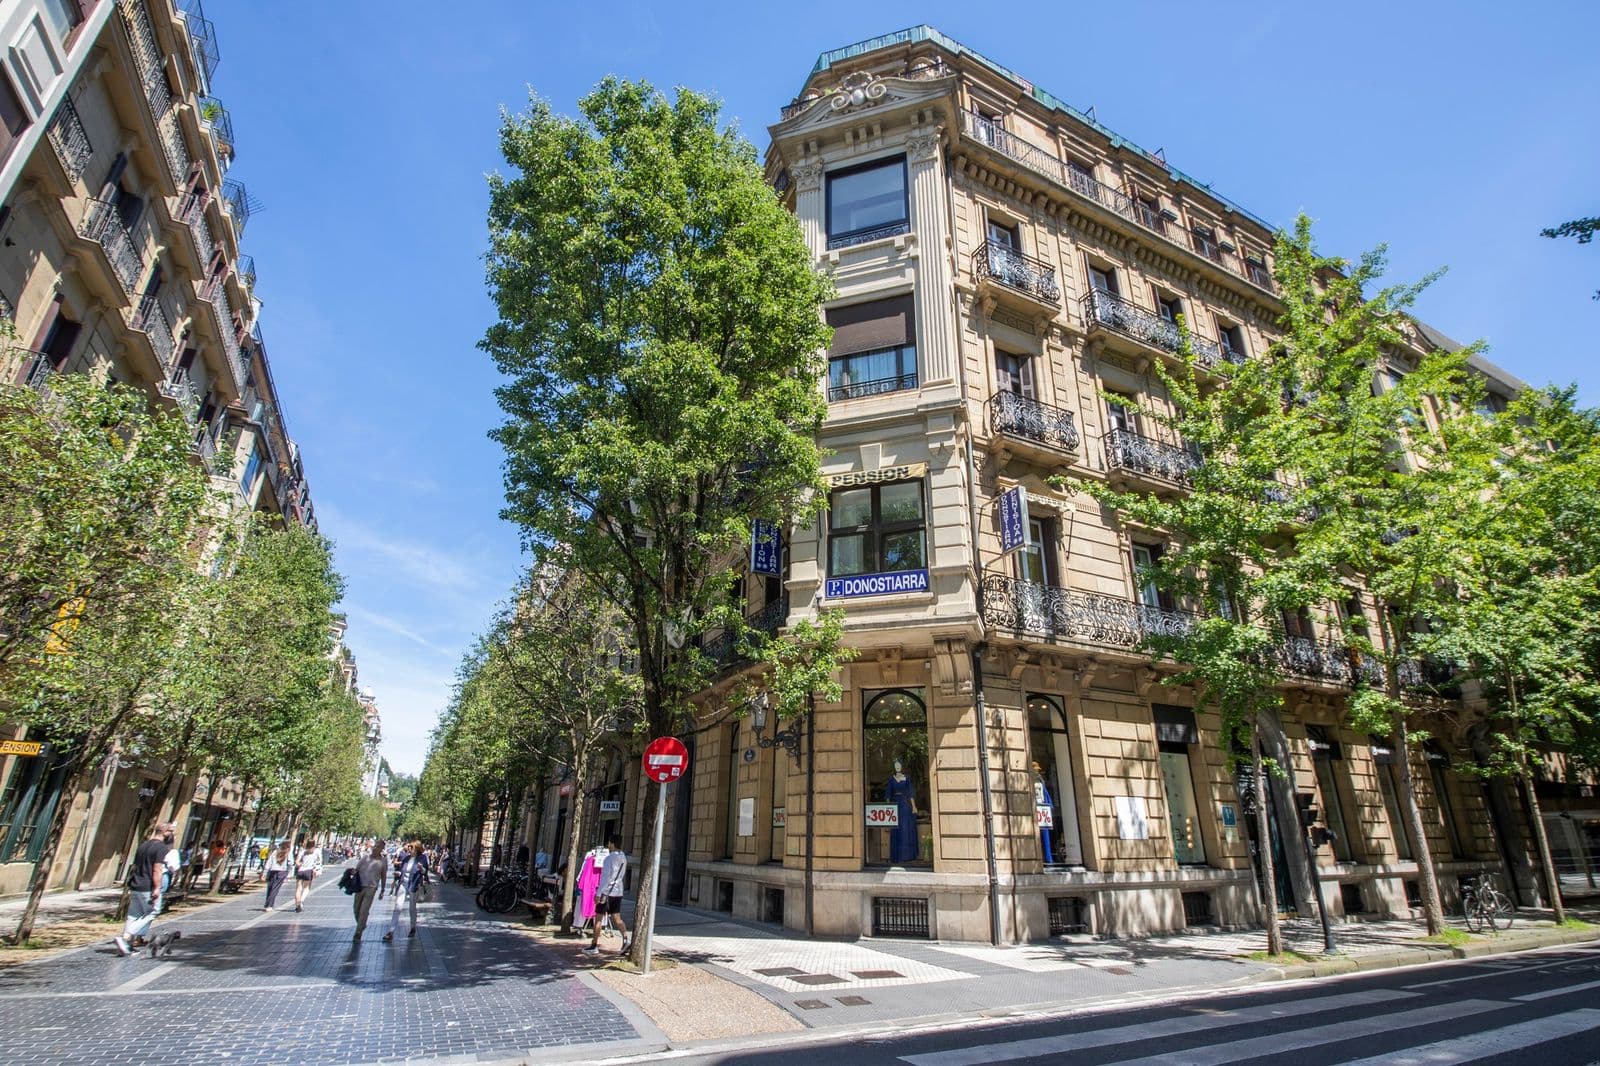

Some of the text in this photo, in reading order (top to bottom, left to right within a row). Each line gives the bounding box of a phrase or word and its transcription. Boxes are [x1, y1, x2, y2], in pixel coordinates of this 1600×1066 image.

[832, 467, 909, 486] PENSION
[832, 573, 927, 595] P DONOSTIARRA
[866, 809, 897, 822] -30%
